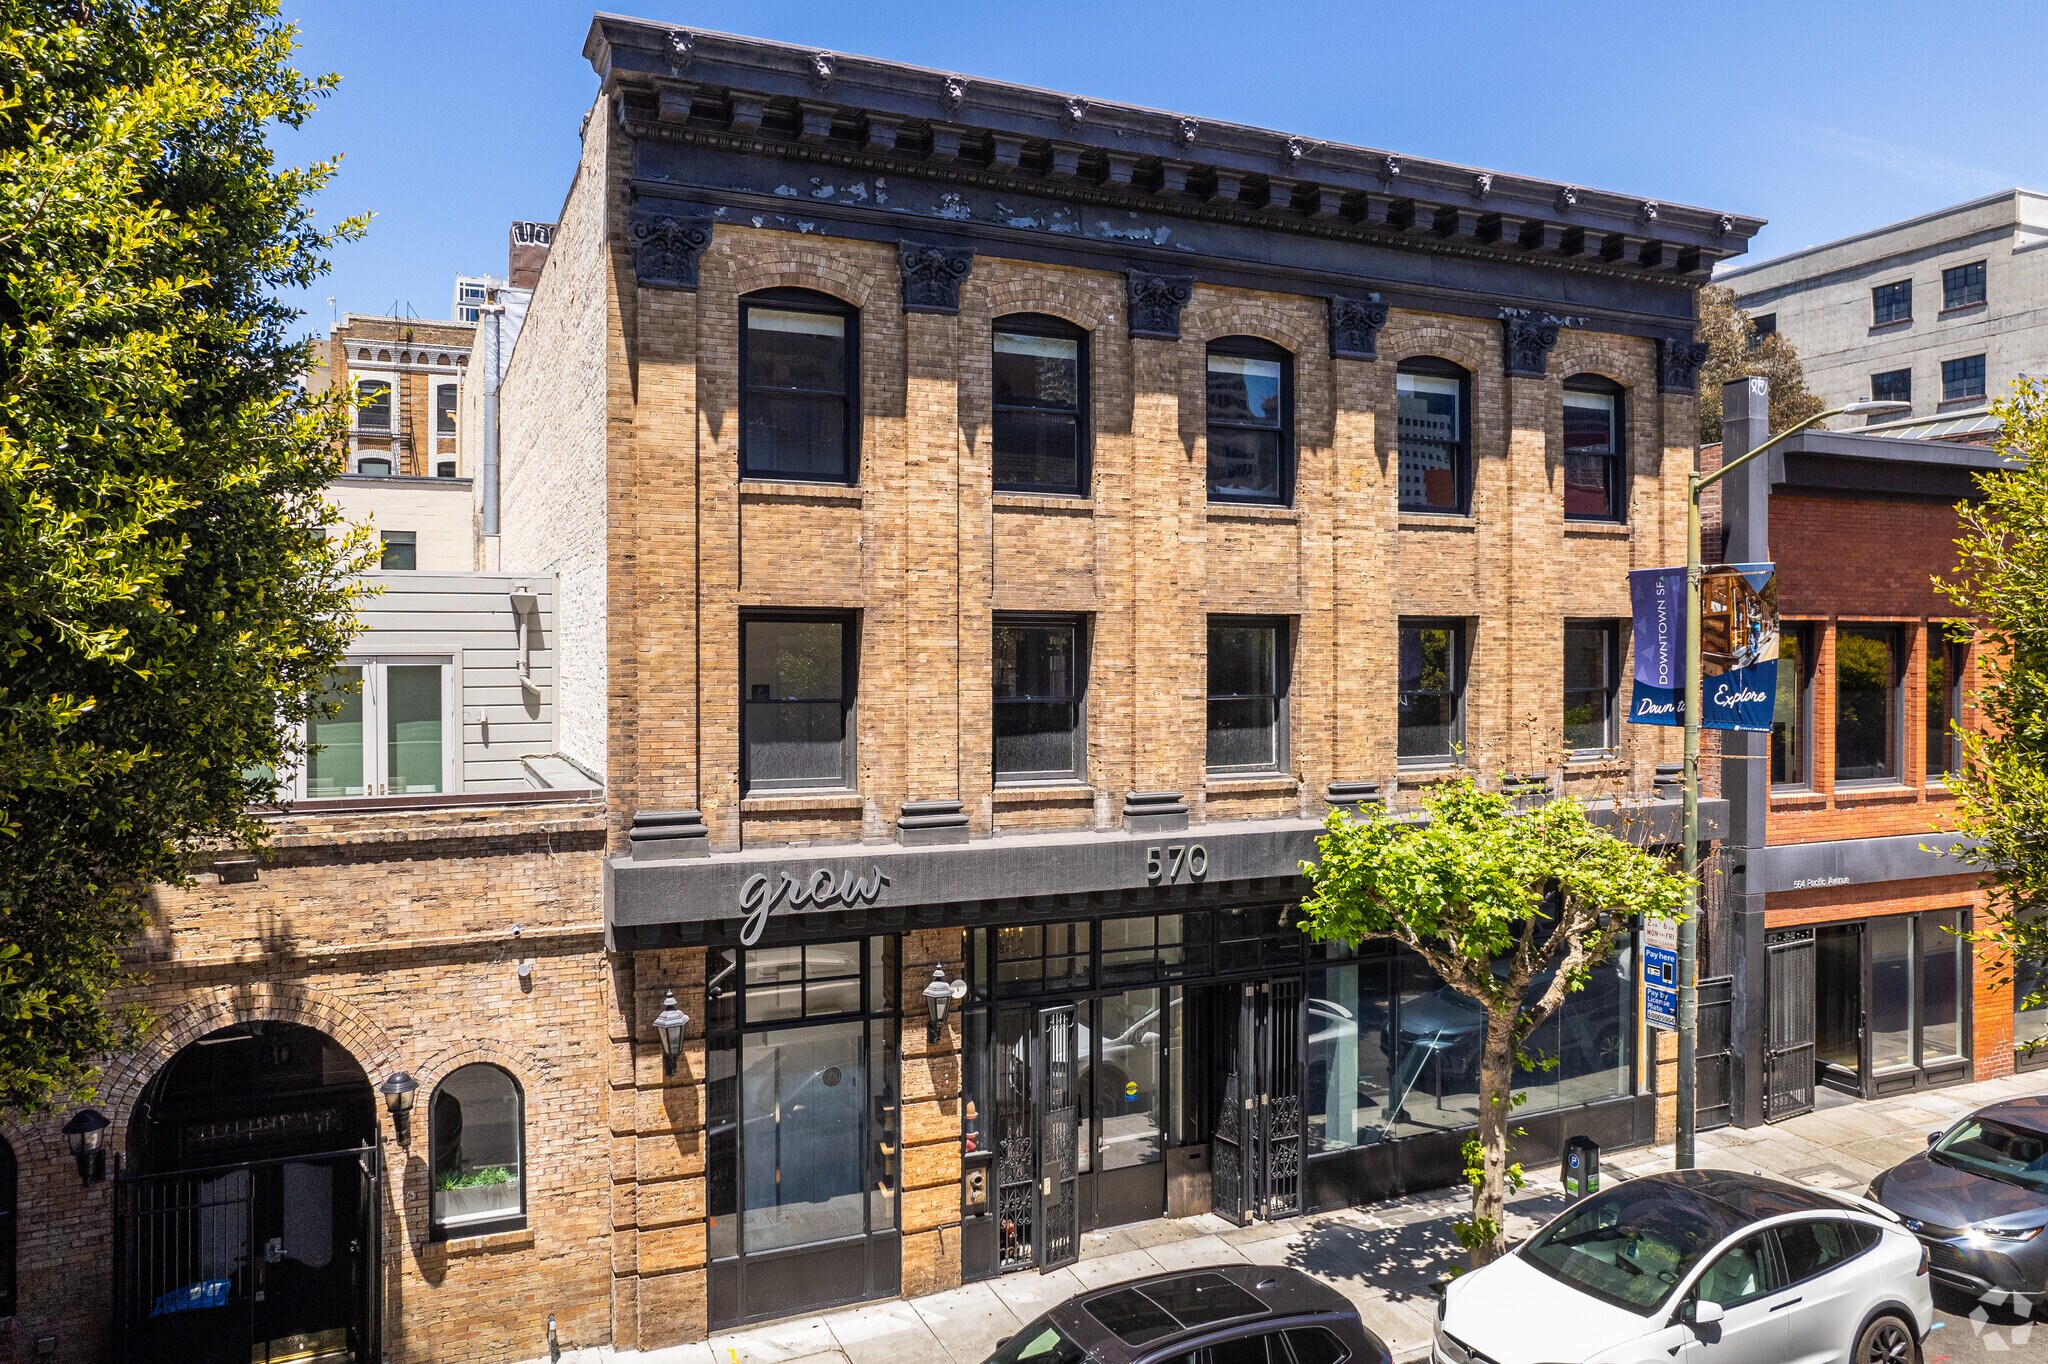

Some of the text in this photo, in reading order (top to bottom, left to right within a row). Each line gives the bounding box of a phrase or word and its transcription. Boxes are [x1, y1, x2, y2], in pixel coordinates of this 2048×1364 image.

[1656, 581, 1668, 685] DOWNTOWN SF
[1714, 683, 1767, 709] Explore
[1637, 698, 1675, 716] Down
[1148, 845, 1208, 880] 570
[1793, 876, 1850, 889] 564 Pacific Avenue
[740, 866, 890, 945] grow
[1647, 929, 1659, 937] MON
[1645, 950, 1675, 962] Pay here
[1647, 988, 1669, 1001] Pay by
[1647, 995, 1671, 1008] License
[1647, 1002, 1663, 1012] Plate
